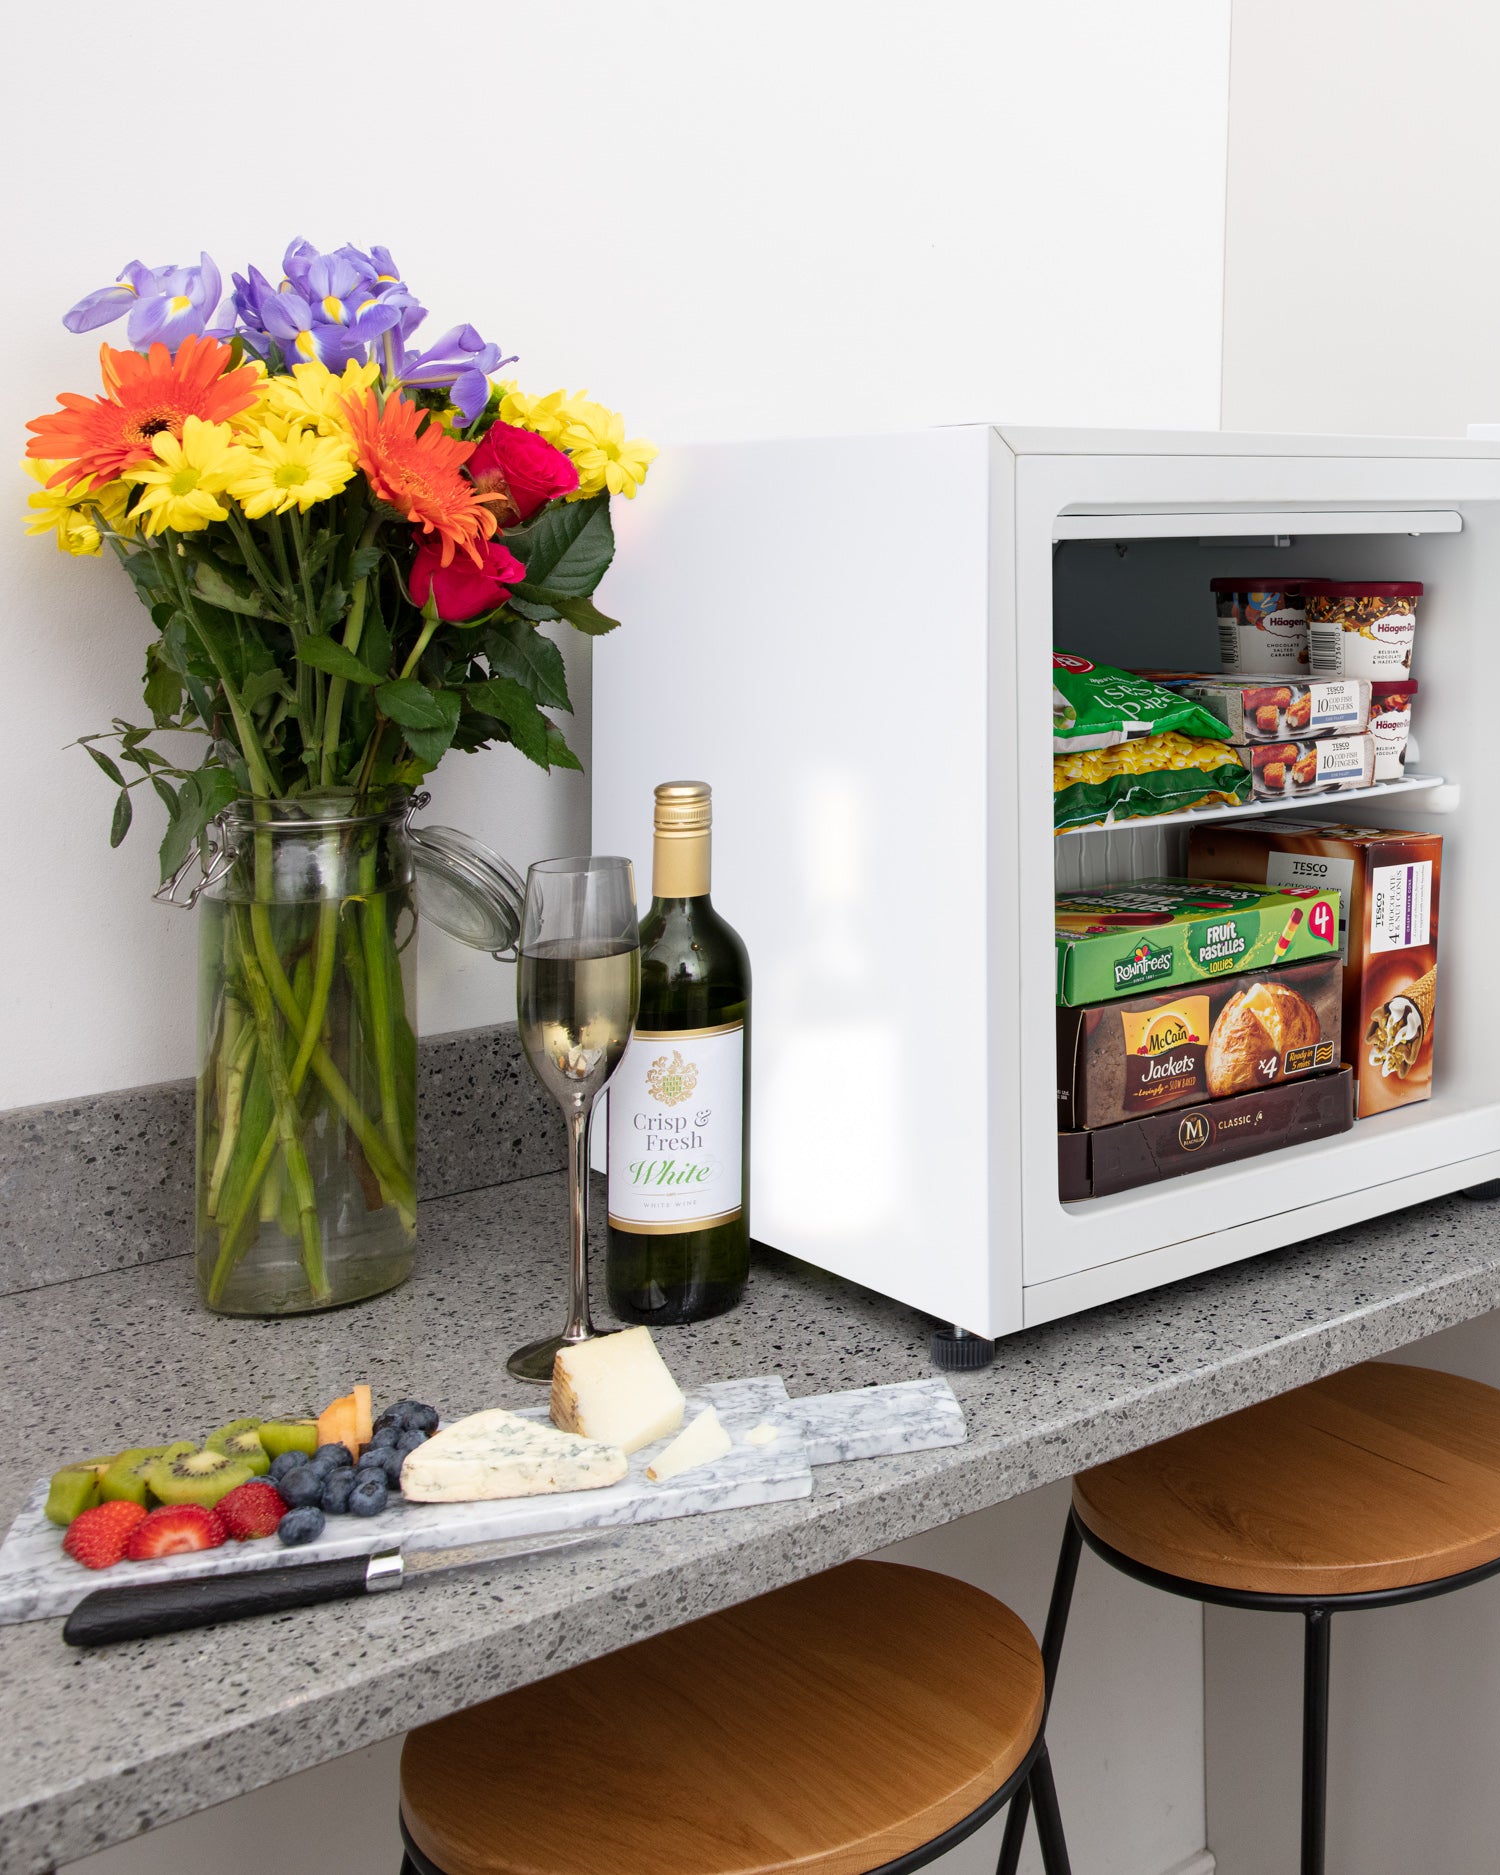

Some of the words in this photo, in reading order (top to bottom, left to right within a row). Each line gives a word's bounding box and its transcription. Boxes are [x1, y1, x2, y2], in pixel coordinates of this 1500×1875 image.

[1326, 685, 1345, 693] TESCO
[1317, 698, 1329, 713] 10
[1329, 703, 1354, 711] FINGERS
[1332, 741, 1350, 749] TESCO
[1323, 755, 1334, 769] 10
[1334, 759, 1359, 767] FINGERS
[1293, 861, 1328, 873] TESCO
[1315, 906, 1330, 935] 4
[1389, 933, 1400, 944] 4
[1149, 1028, 1187, 1053] McCain
[1289, 1051, 1306, 1062] Ready
[1142, 1055, 1195, 1083] Jackets
[1258, 1056, 1278, 1079] x4
[1297, 1060, 1311, 1069] mins
[1138, 1085, 1165, 1098] Lovingly
[1169, 1080, 1181, 1091] SLOW
[1182, 1076, 1197, 1088] BAKED
[633, 1112, 687, 1134] Crisp
[694, 1108, 712, 1127] &
[1218, 1114, 1252, 1130] CLASSIC
[1185, 1120, 1203, 1140] M
[646, 1131, 703, 1151] Fresh
[629, 1160, 711, 1185] White
[643, 1201, 671, 1209] WHITE
[675, 1200, 697, 1208] WINE
